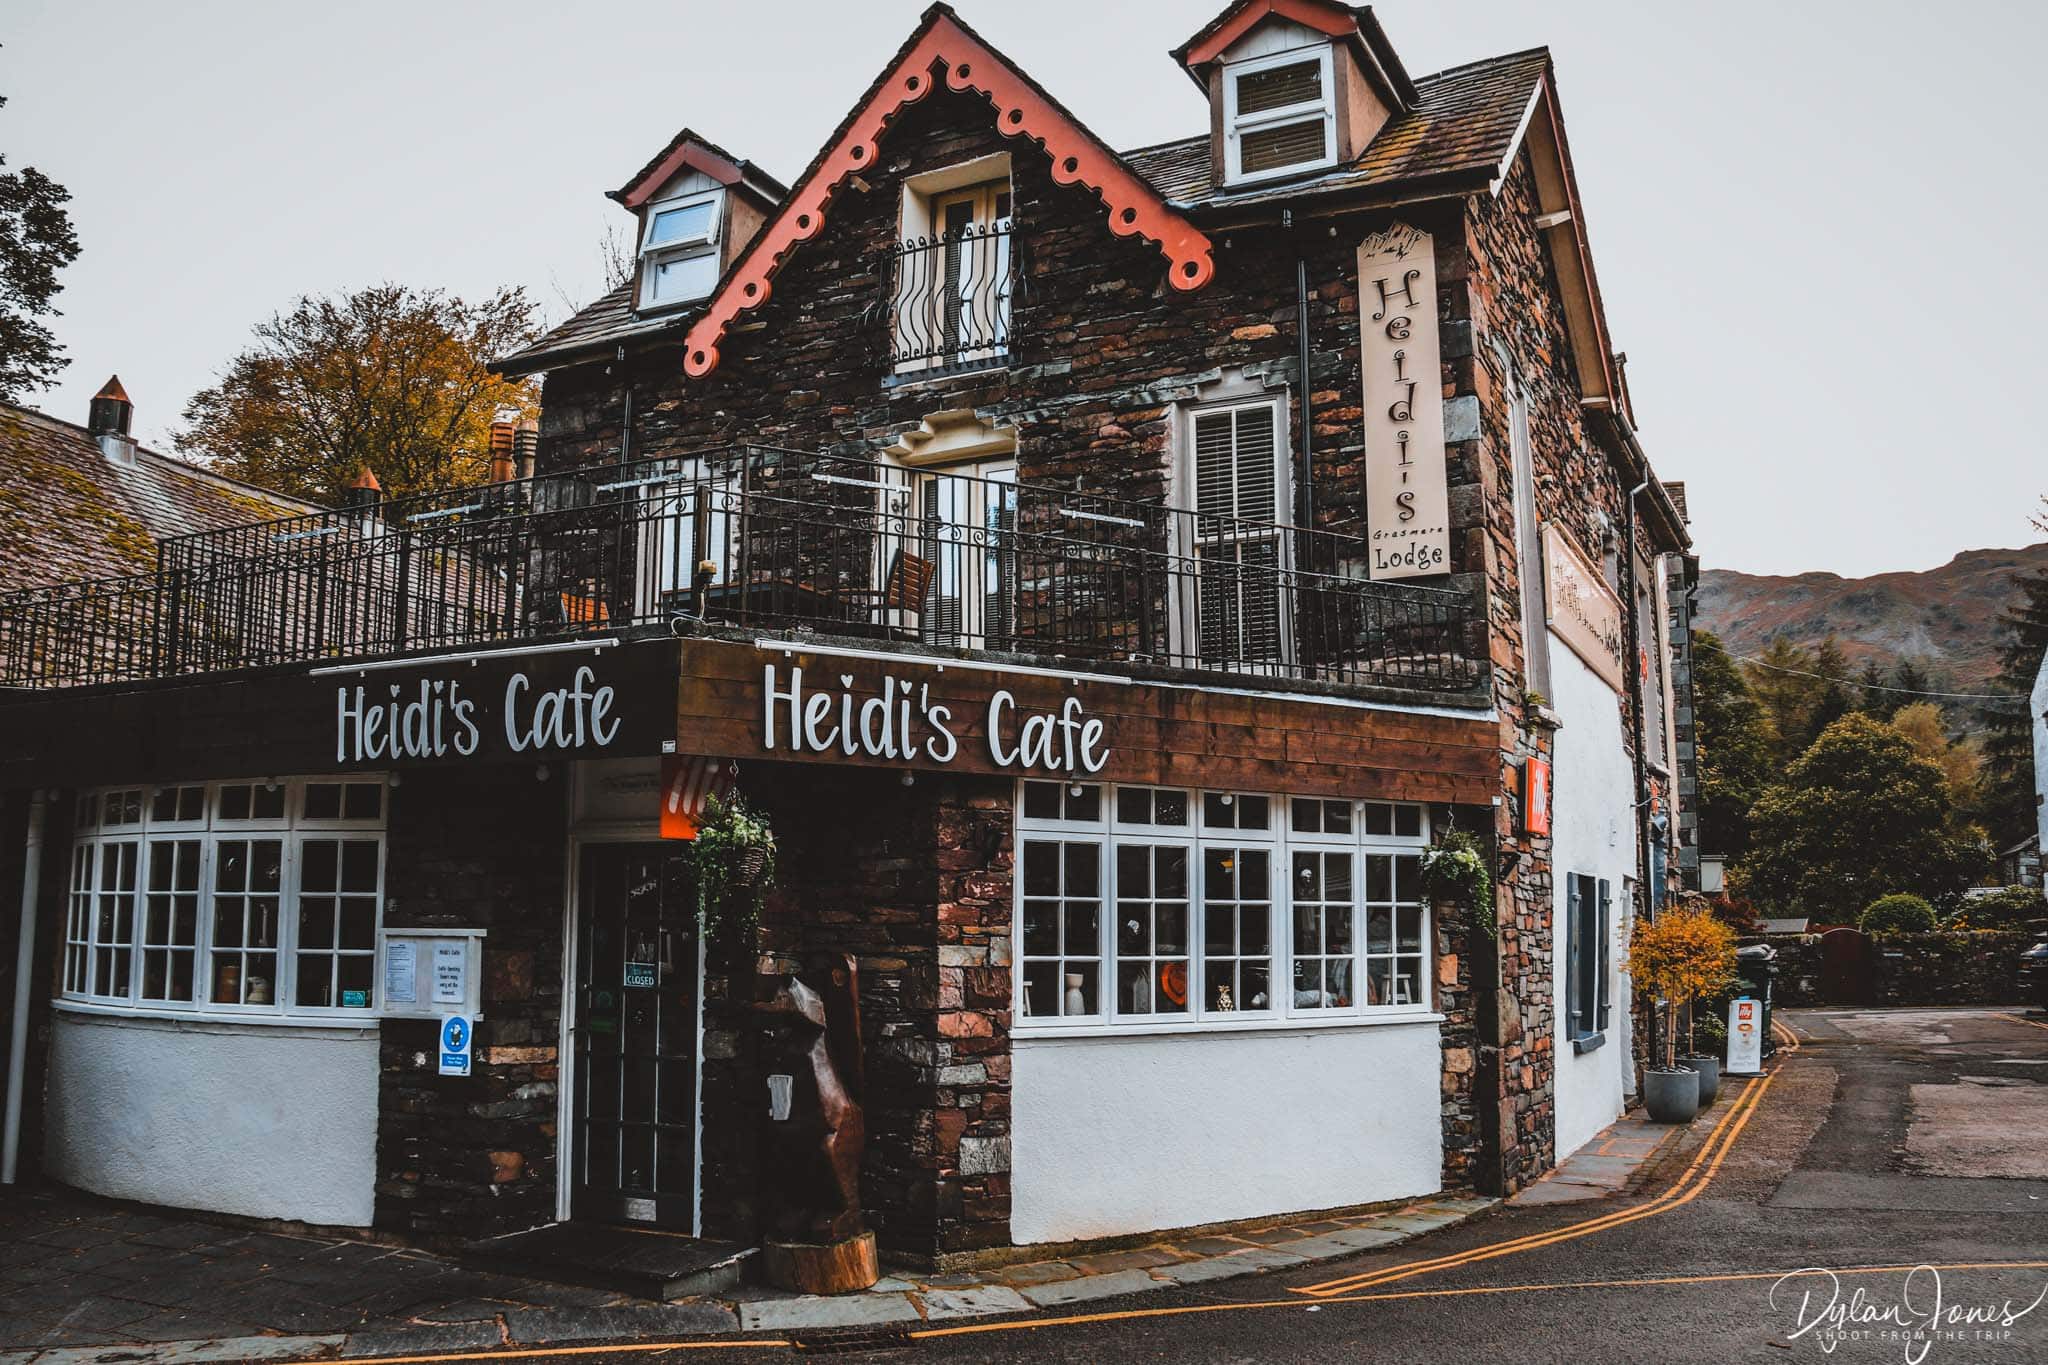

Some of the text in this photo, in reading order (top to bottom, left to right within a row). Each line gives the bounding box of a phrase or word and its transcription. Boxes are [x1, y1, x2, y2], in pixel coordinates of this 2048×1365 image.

[1372, 269, 1420, 521] Heidi's
[1373, 527, 1443, 539] Grasmere
[1375, 541, 1442, 570] Lodge
[337, 666, 621, 762] Heidi's Cafe
[764, 664, 1110, 773] Heidi's Cafe
[627, 975, 655, 986] CLOSED
